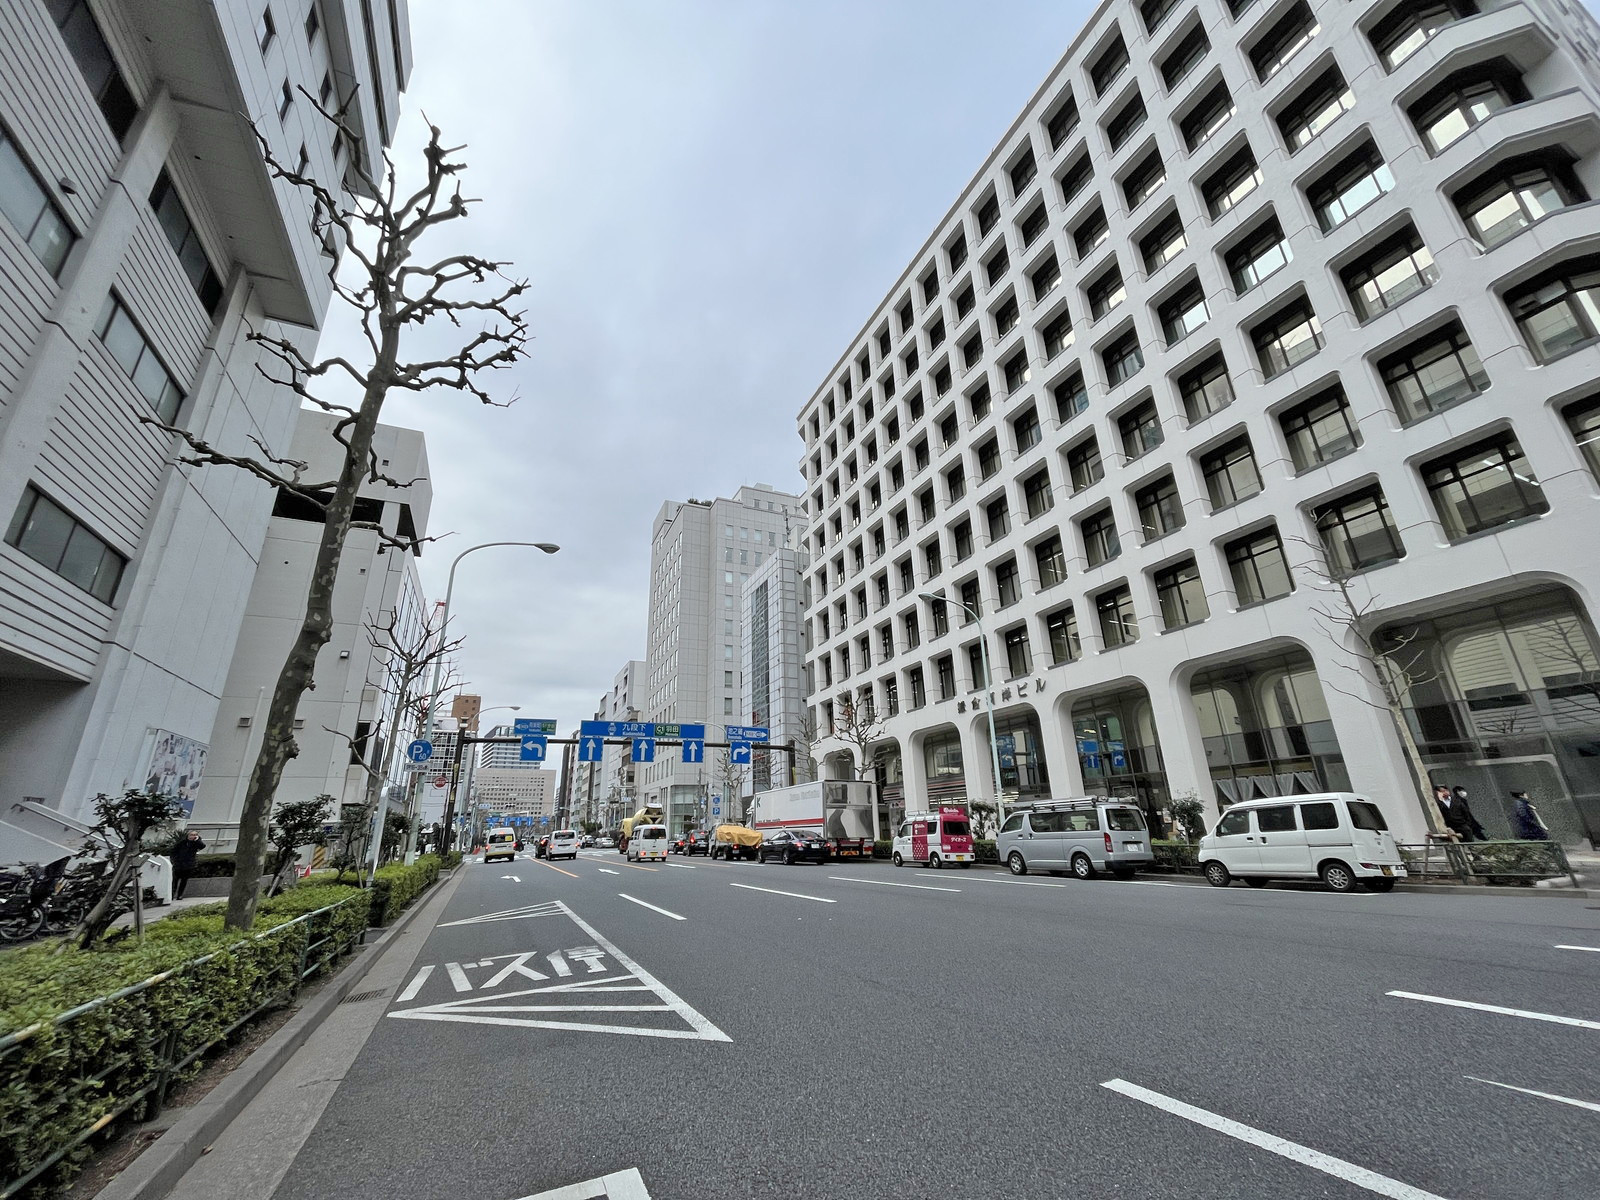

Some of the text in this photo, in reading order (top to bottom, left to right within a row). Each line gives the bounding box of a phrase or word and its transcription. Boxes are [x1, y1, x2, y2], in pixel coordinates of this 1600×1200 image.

[622, 723, 646, 731] 九段下
[666, 725, 679, 733] 羽田
[412, 745, 427, 760] P 60
